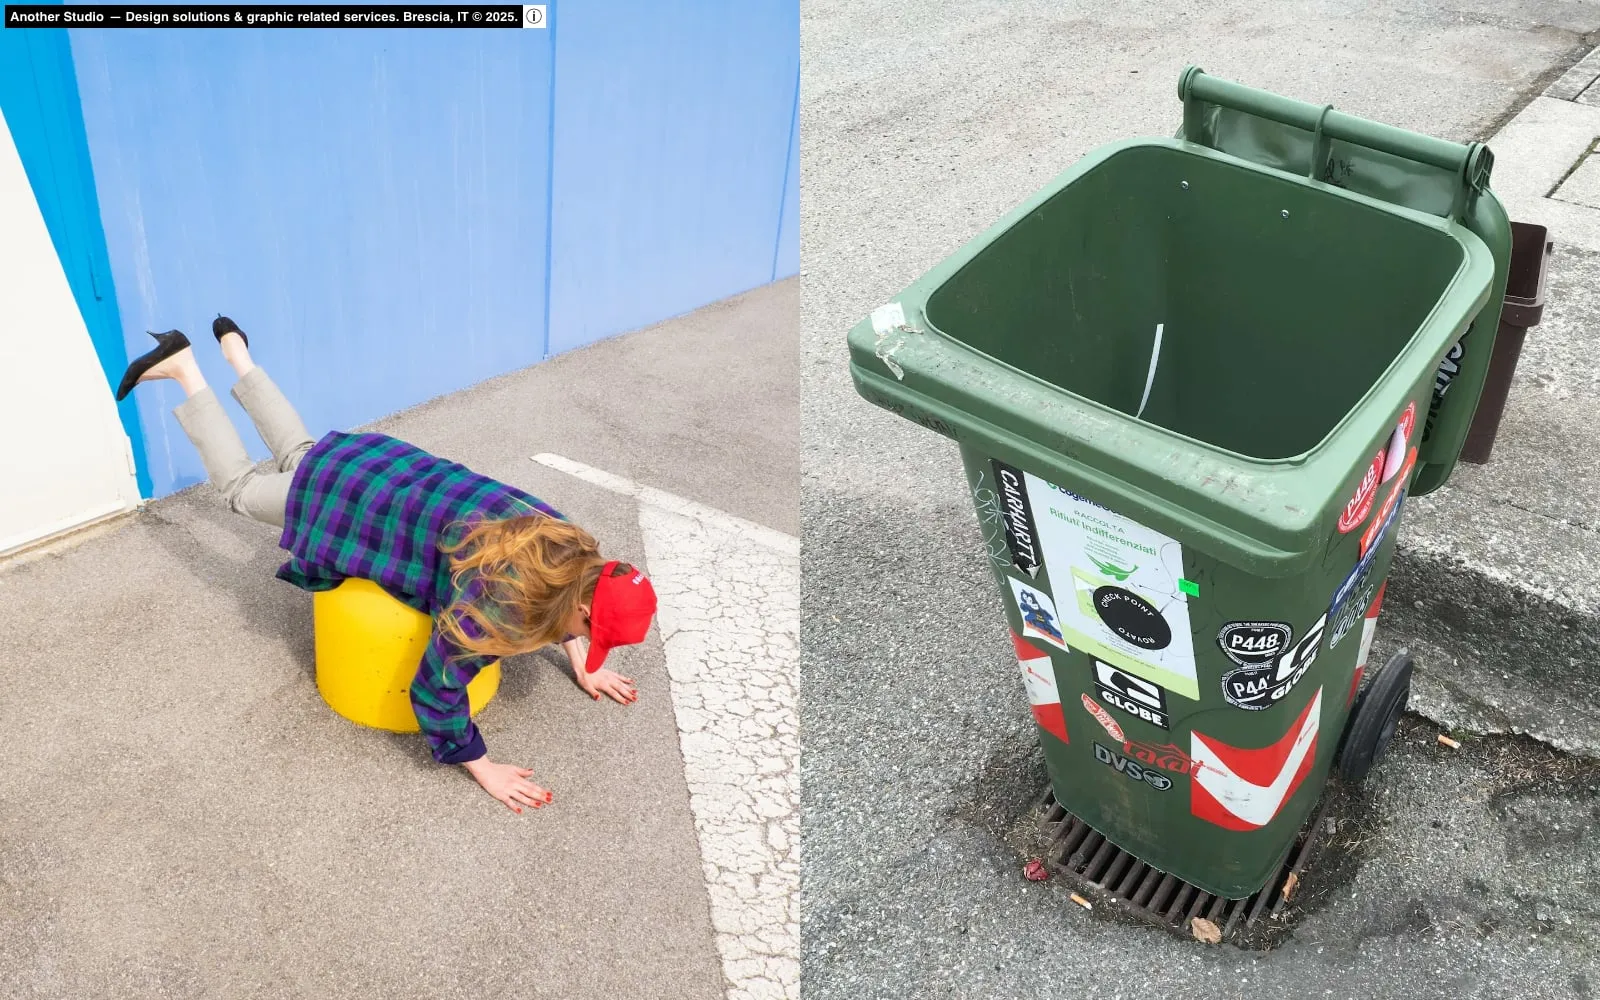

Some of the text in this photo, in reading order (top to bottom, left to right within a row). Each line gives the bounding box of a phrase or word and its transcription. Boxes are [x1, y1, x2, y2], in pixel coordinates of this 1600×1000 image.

[1001, 469, 1037, 566] CARHARTT
[1074, 509, 1126, 535] RACCOLTA
[1049, 506, 1080, 527] Rifiuti
[1082, 521, 1158, 557] Indifferenziati
[1101, 592, 1155, 617] CHECK POINT
[1118, 627, 1156, 644] ROVATO
[1231, 633, 1279, 651] P448
[1232, 673, 1270, 698] P44
[1101, 690, 1163, 726] GLOBE
[1095, 743, 1144, 781] DVS
